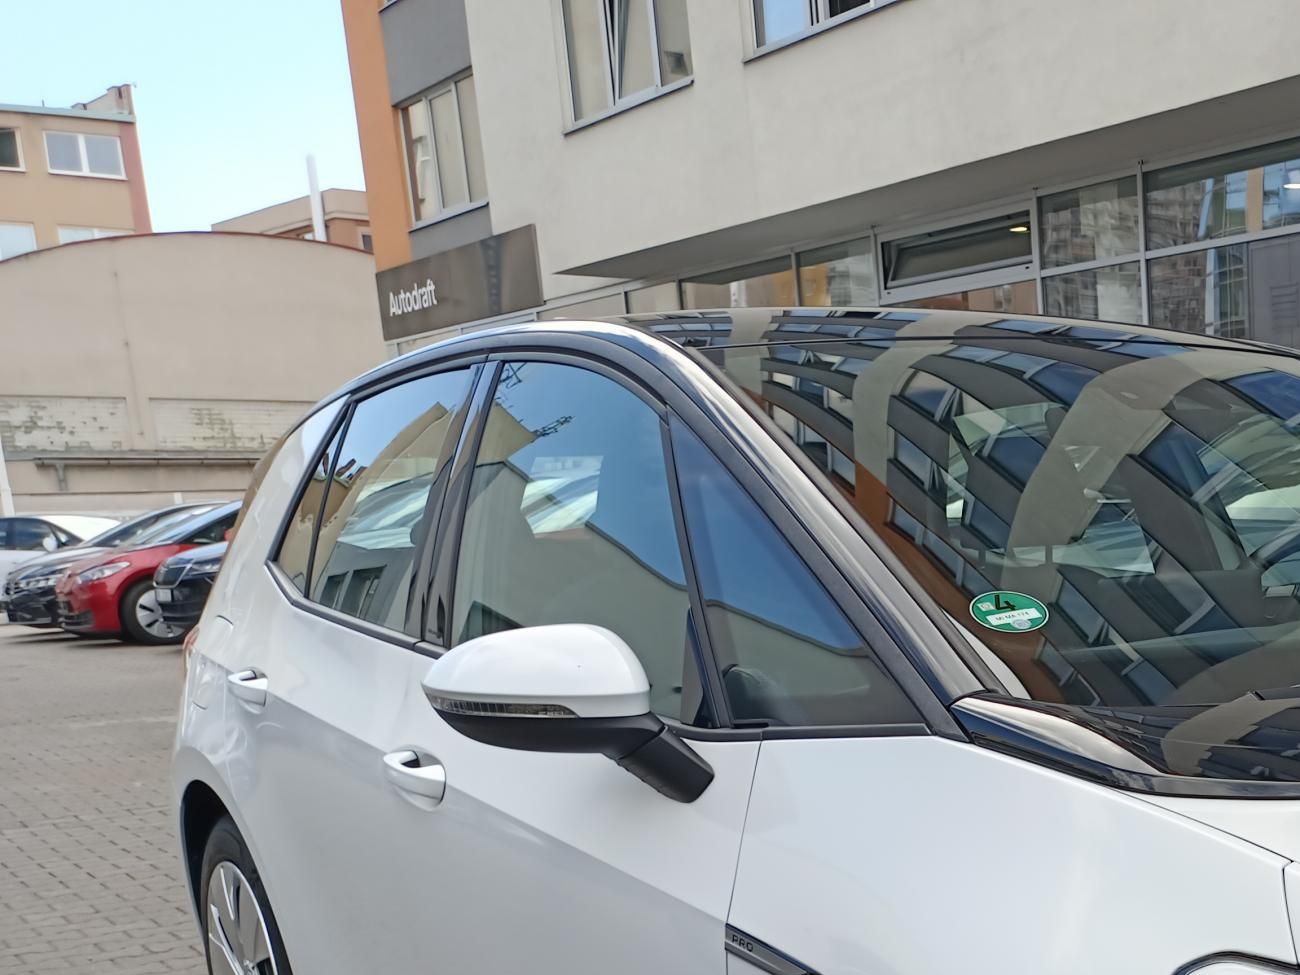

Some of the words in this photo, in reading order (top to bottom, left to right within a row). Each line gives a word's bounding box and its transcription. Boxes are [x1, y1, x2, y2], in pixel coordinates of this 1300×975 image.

[389, 278, 438, 317] Autodraft
[994, 594, 1017, 610] 4
[732, 934, 754, 953] PRO
